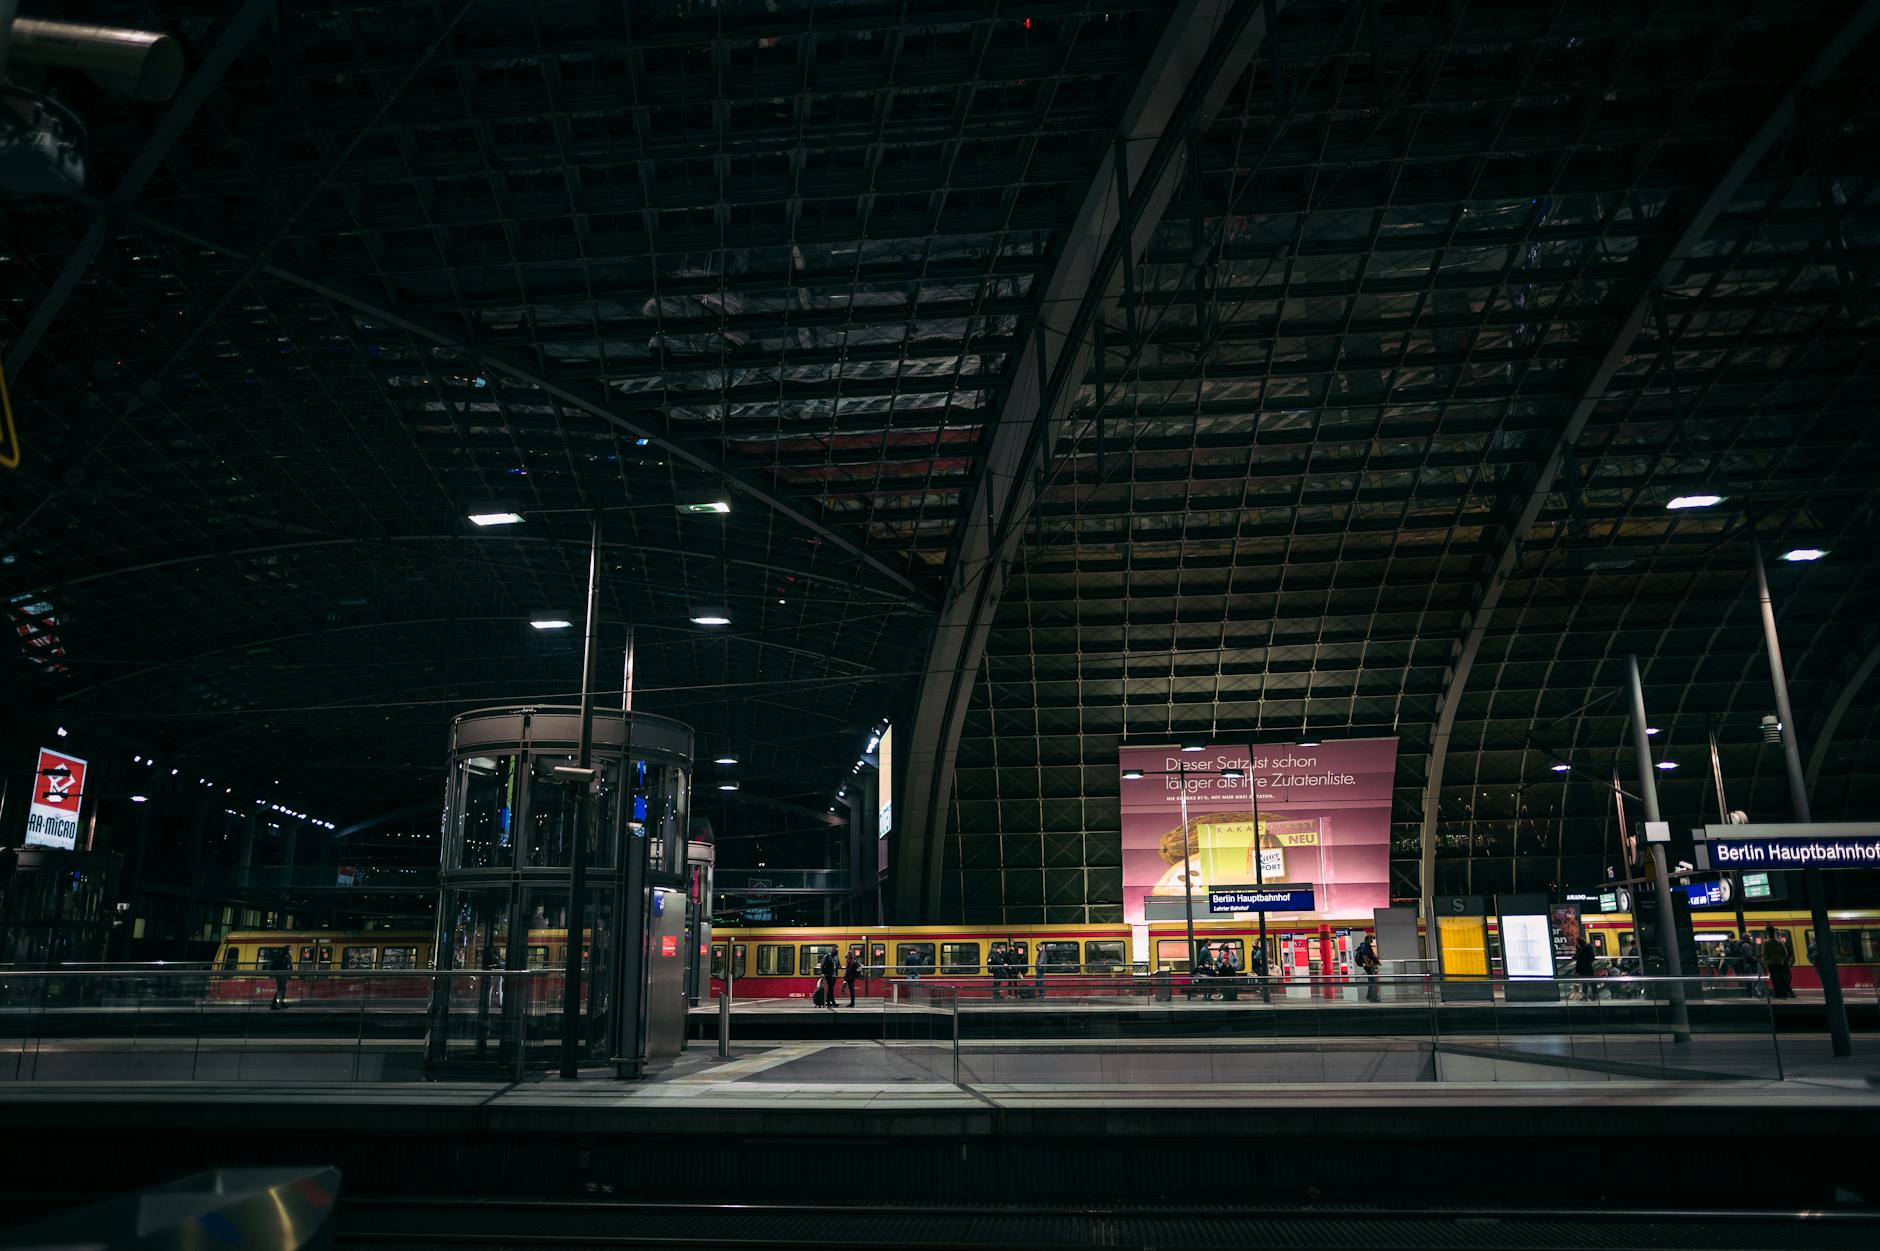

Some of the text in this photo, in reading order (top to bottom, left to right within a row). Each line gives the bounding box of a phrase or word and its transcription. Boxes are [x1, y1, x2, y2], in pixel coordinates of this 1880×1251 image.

[1165, 754, 1317, 771] Dieser Satz ist schon
[1165, 776, 1213, 793] länger
[1217, 776, 1238, 788] als
[1271, 770, 1356, 788] Zutatenliste.
[1217, 824, 1264, 833] KAKAO
[1288, 834, 1315, 844] NEU
[1717, 841, 1880, 864] Berlin Hauptbahnhof
[1212, 893, 1291, 904] Berlin Hauptbahnhof
[1452, 898, 1465, 912] S
